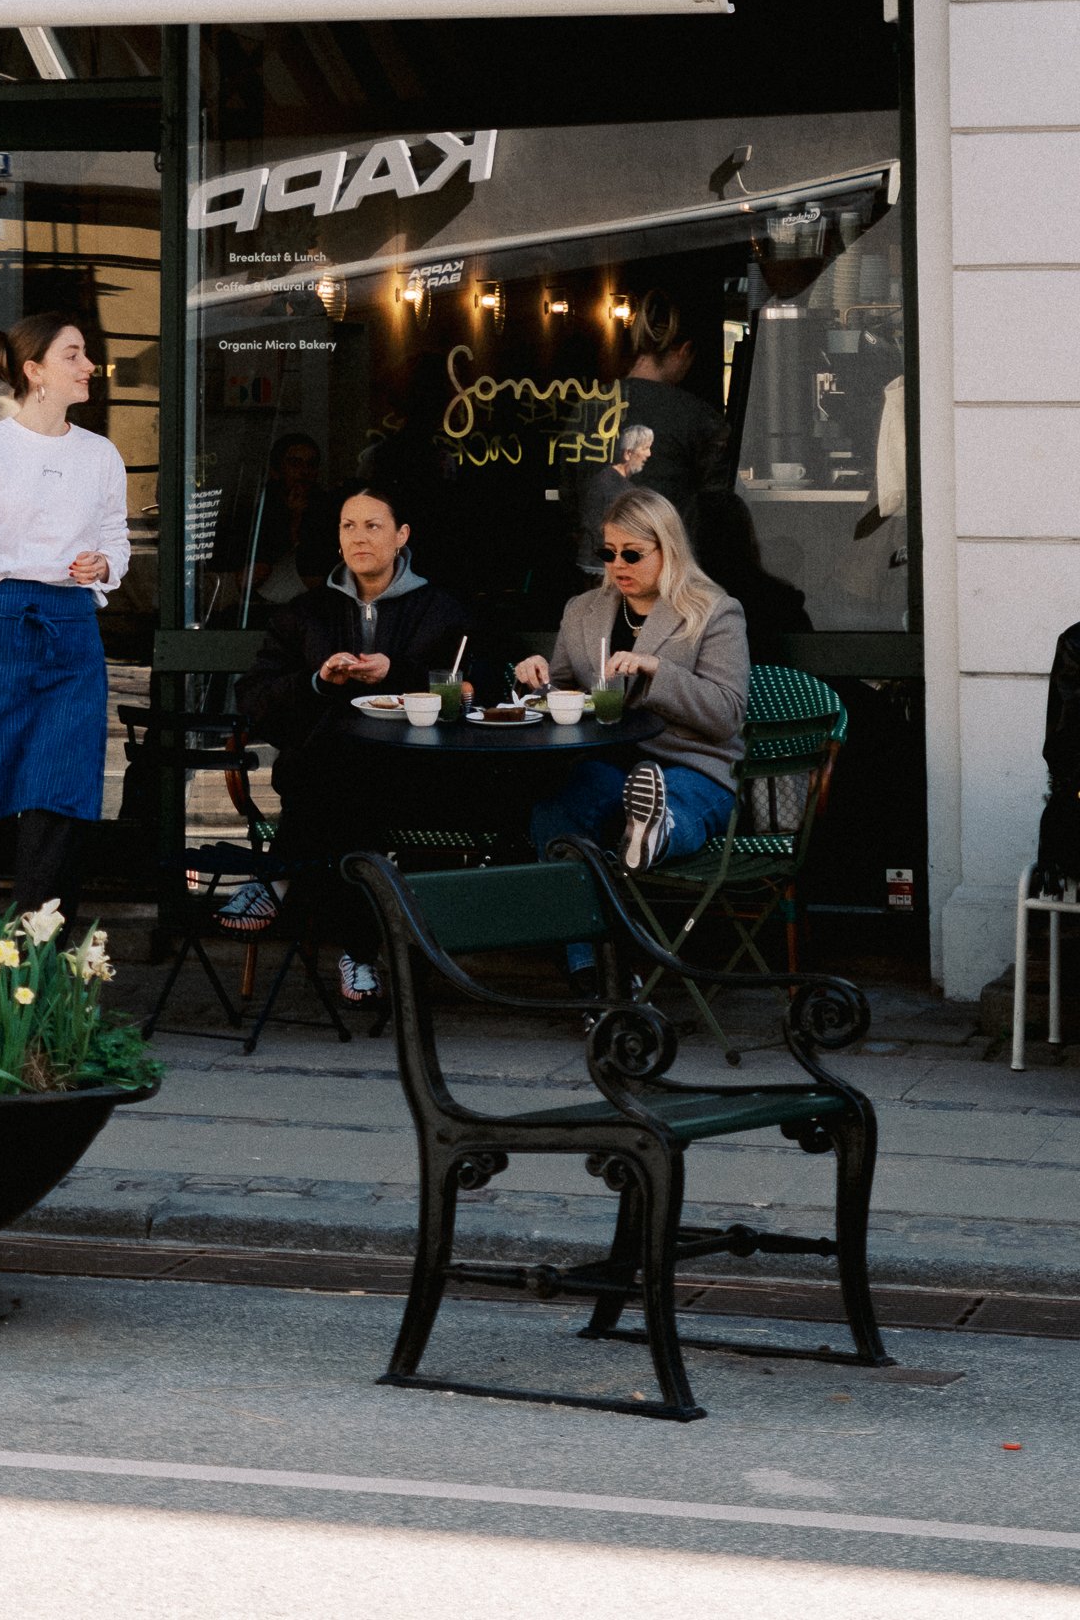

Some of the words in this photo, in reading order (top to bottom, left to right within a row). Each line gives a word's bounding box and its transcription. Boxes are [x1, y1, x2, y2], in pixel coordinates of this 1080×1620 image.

[229, 252, 281, 263] Breakfast
[283, 253, 292, 262] &
[294, 252, 327, 262] Lunch
[214, 282, 250, 292] Coffee
[264, 282, 305, 291] Natural
[218, 340, 262, 353] Organic
[265, 340, 296, 350] Micro
[299, 340, 337, 352] Bakery
[442, 345, 629, 438] Sonny
